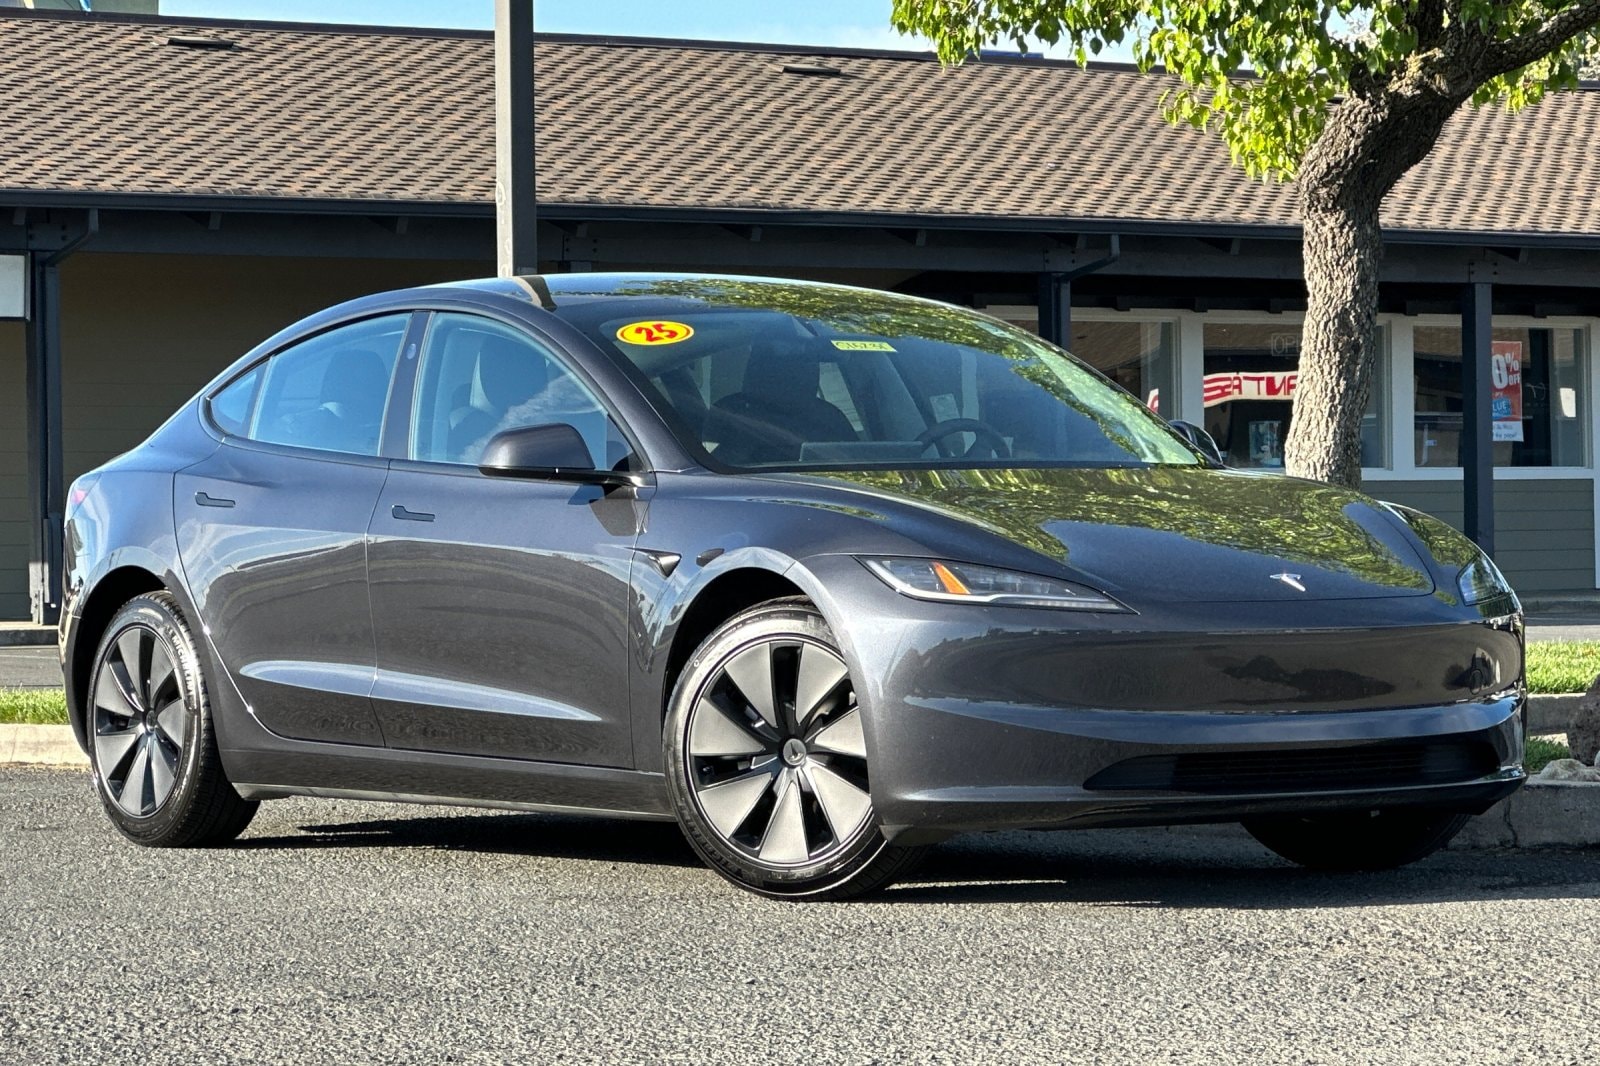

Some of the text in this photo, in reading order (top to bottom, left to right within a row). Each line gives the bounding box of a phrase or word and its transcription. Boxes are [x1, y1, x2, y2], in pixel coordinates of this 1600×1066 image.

[635, 323, 678, 342] 25
[1491, 352, 1519, 389] 0%
[1508, 374, 1520, 386] OFF
[1492, 401, 1508, 412] LUE
